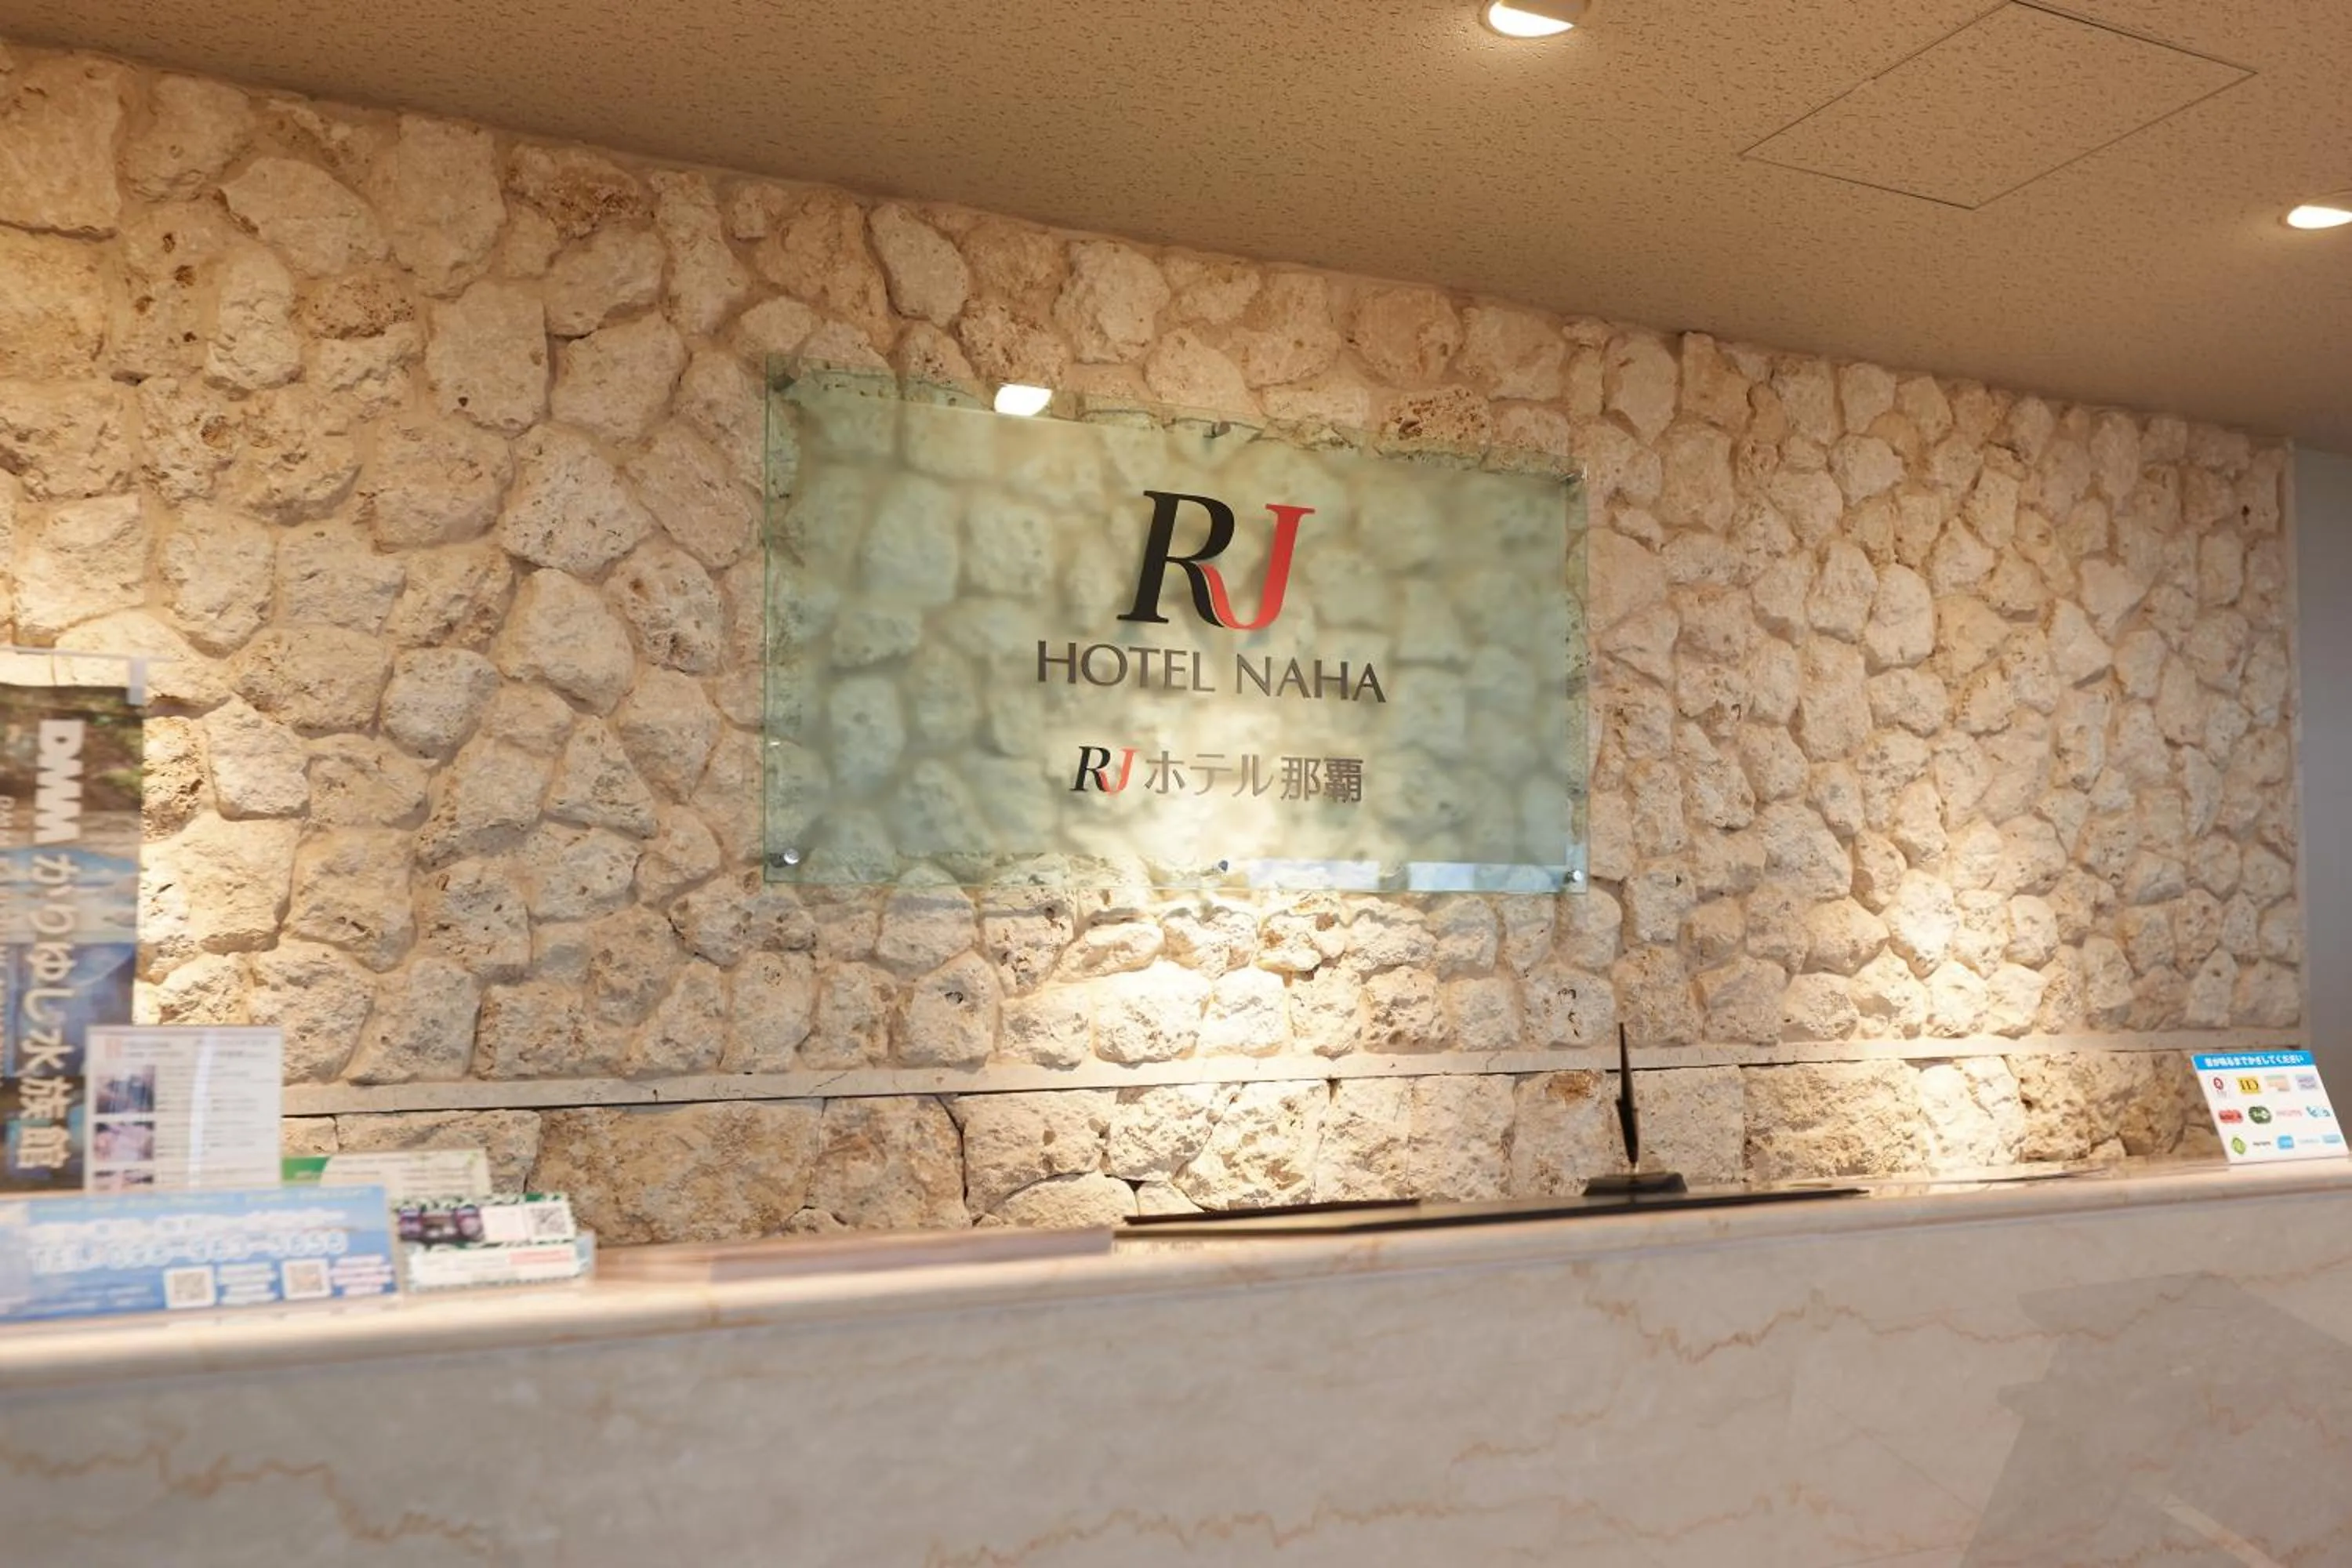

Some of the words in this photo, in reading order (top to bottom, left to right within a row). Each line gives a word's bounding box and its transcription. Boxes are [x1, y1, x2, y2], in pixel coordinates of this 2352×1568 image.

[1116, 489, 1316, 630] RJ
[1037, 640, 1215, 692] HOTEL
[1236, 653, 1387, 703] NAHA
